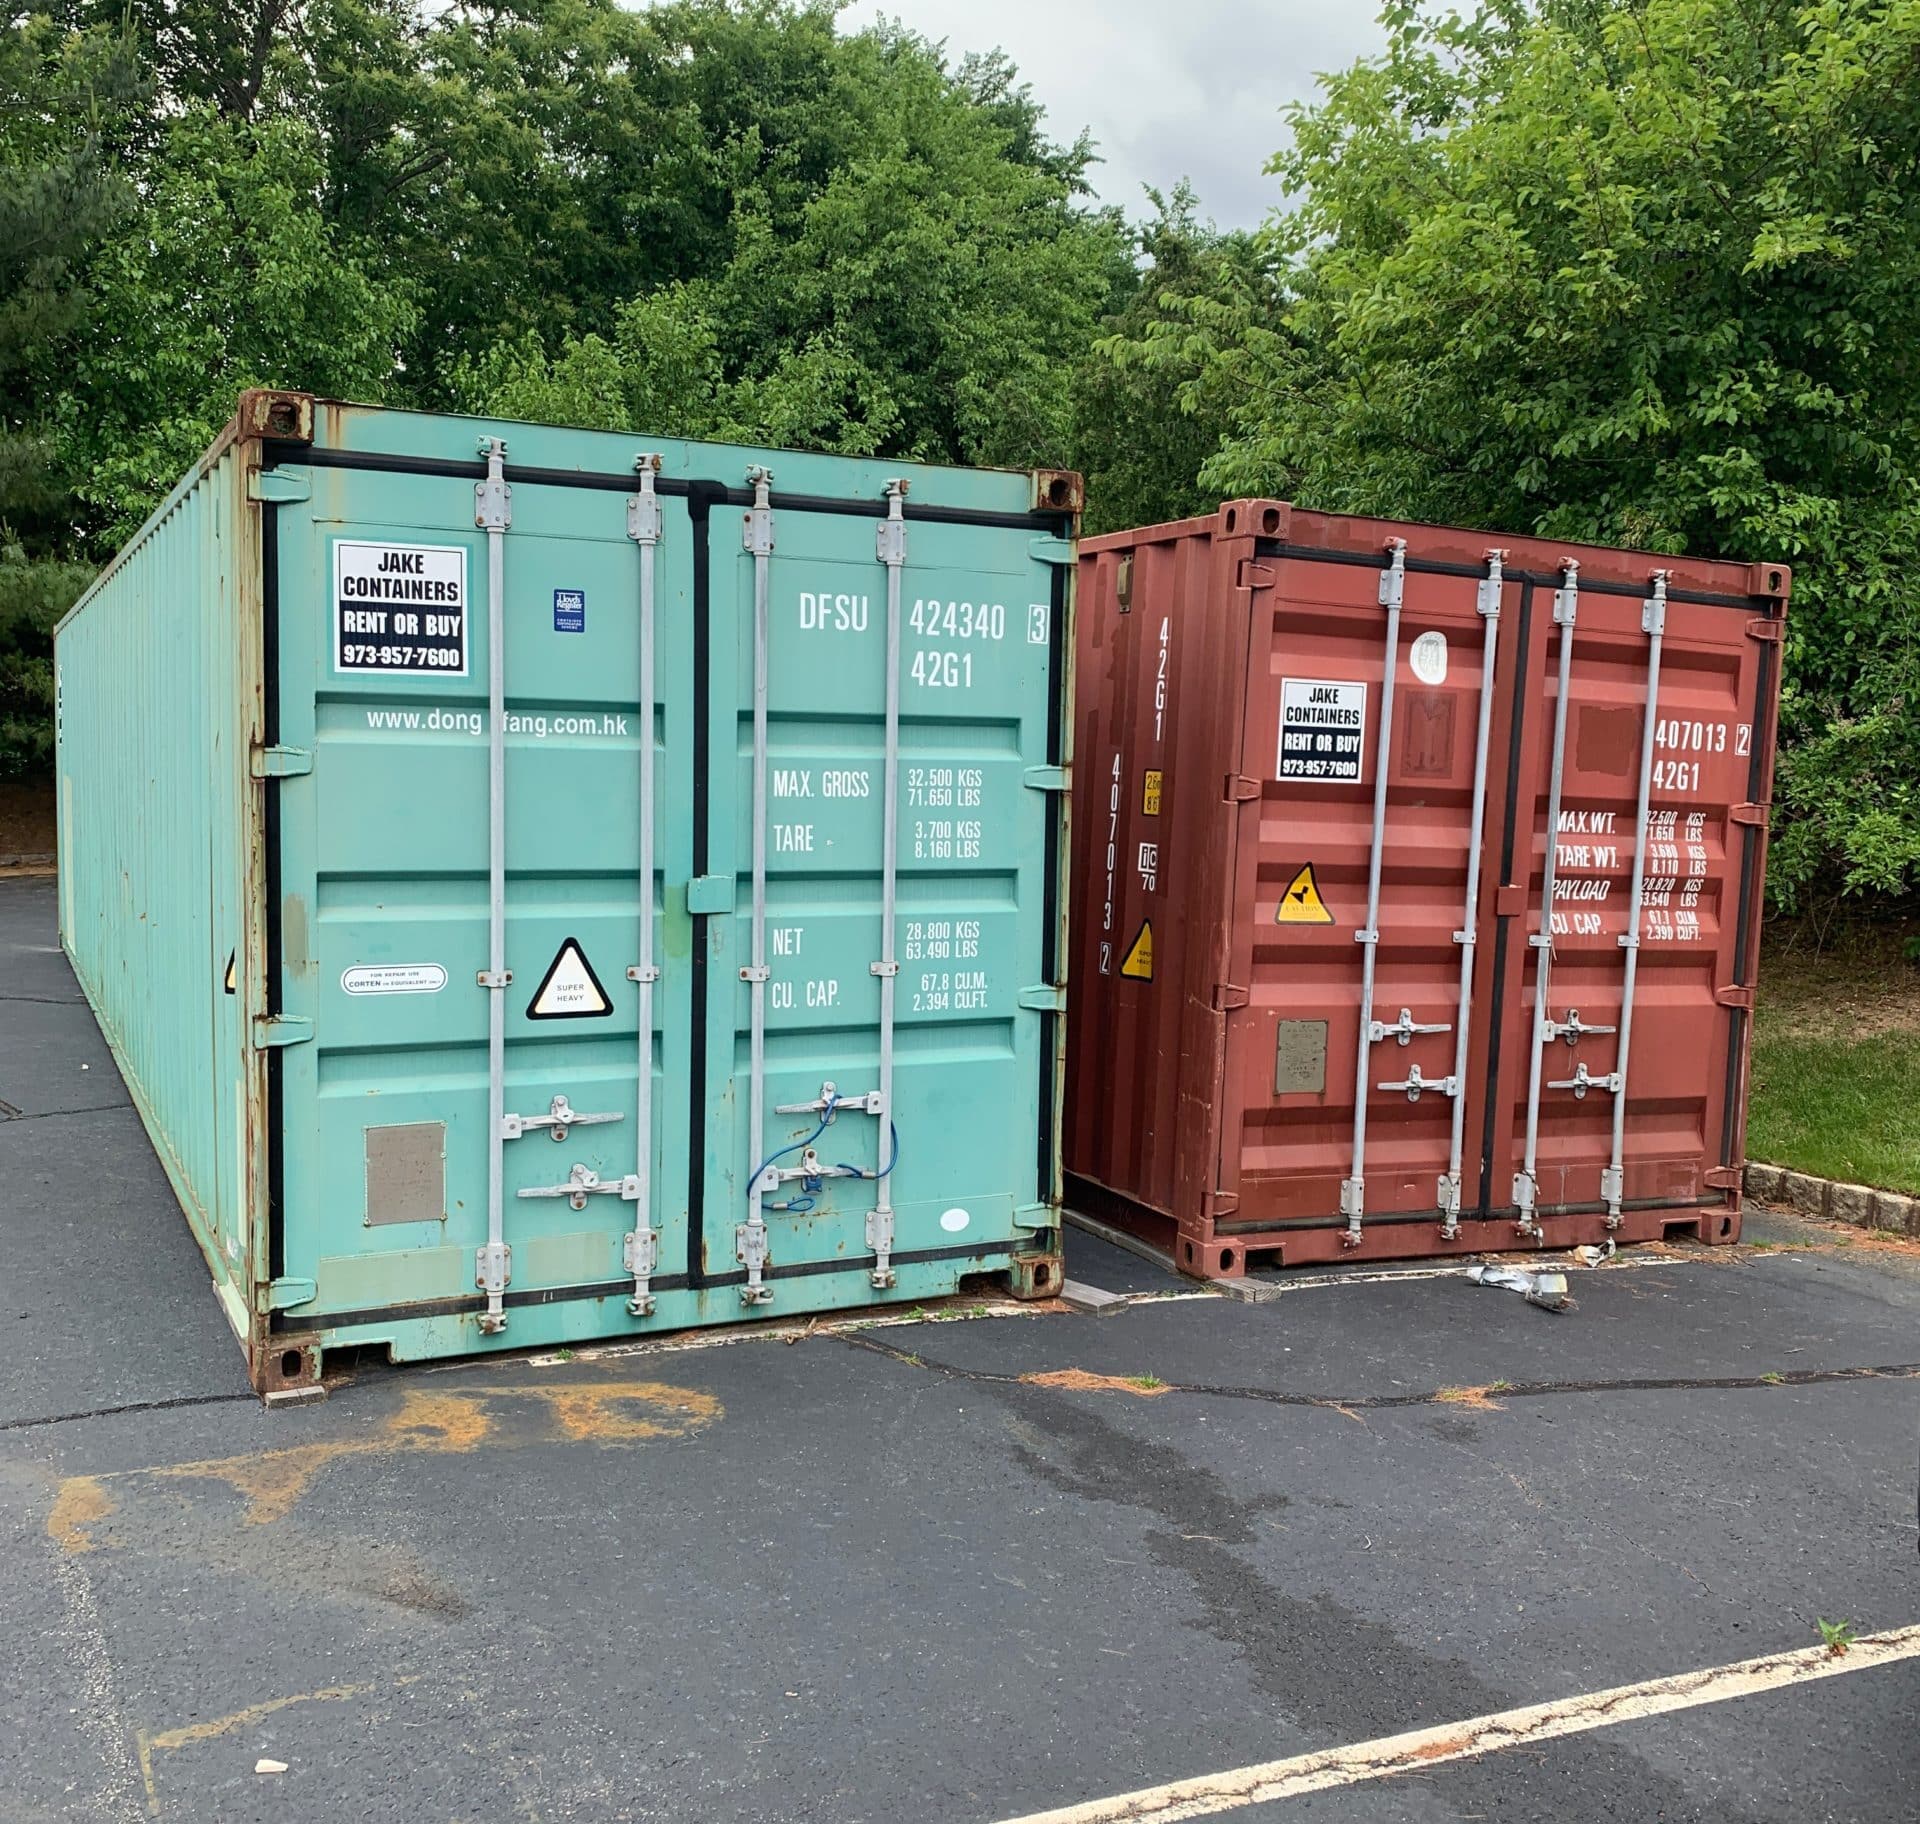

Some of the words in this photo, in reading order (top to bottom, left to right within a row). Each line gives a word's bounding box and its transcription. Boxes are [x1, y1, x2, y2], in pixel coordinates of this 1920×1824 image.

[378, 552, 424, 574] JAKE
[343, 576, 458, 601] CONTAINERS
[343, 610, 388, 634] RENT
[394, 613, 419, 635] OR
[425, 614, 461, 637] BUY
[800, 592, 868, 632] DFSU
[910, 599, 1005, 640] 424340
[1031, 607, 1046, 642] 3
[343, 645, 460, 667] 973-957-7600
[911, 651, 972, 688] 42G1
[1156, 616, 1168, 741] 42G1
[1309, 687, 1339, 704] JAKE
[1286, 706, 1360, 725] CONTAINERS
[1284, 732, 1313, 751] RENT
[1316, 734, 1333, 752] OR
[1336, 735, 1360, 753] BUY
[1655, 719, 1727, 752] 407013
[1282, 759, 1357, 776] 973-957-7600
[1652, 760, 1700, 792] 42G1
[773, 770, 815, 798] MAX.
[822, 771, 870, 798] GROSS
[957, 769, 983, 787] KGS
[957, 789, 981, 806] LBS
[1686, 812, 1707, 826] KGS
[773, 825, 814, 851] TARE
[956, 821, 981, 839] KGS
[1646, 825, 1675, 841] 1.650
[1685, 827, 1703, 842] LBS
[956, 841, 979, 858] LBS
[1103, 753, 1121, 930] 407013
[1556, 845, 1591, 867] TARE
[1593, 847, 1620, 868] WT.
[1687, 845, 1707, 860] KGS
[1689, 860, 1707, 875] LBS
[1142, 874, 1155, 891] 70
[1552, 880, 1611, 901] PAYLOAD
[1684, 879, 1705, 892] KGS
[1680, 892, 1699, 907] LBS
[955, 921, 981, 939] KGS
[1551, 913, 1573, 935] CU.
[773, 928, 804, 955] NET
[955, 940, 978, 958] LBS
[348, 980, 381, 988] CORTEN
[921, 973, 949, 991] 67.8
[772, 982, 798, 1009] CU.
[806, 980, 841, 1006] CAP.
